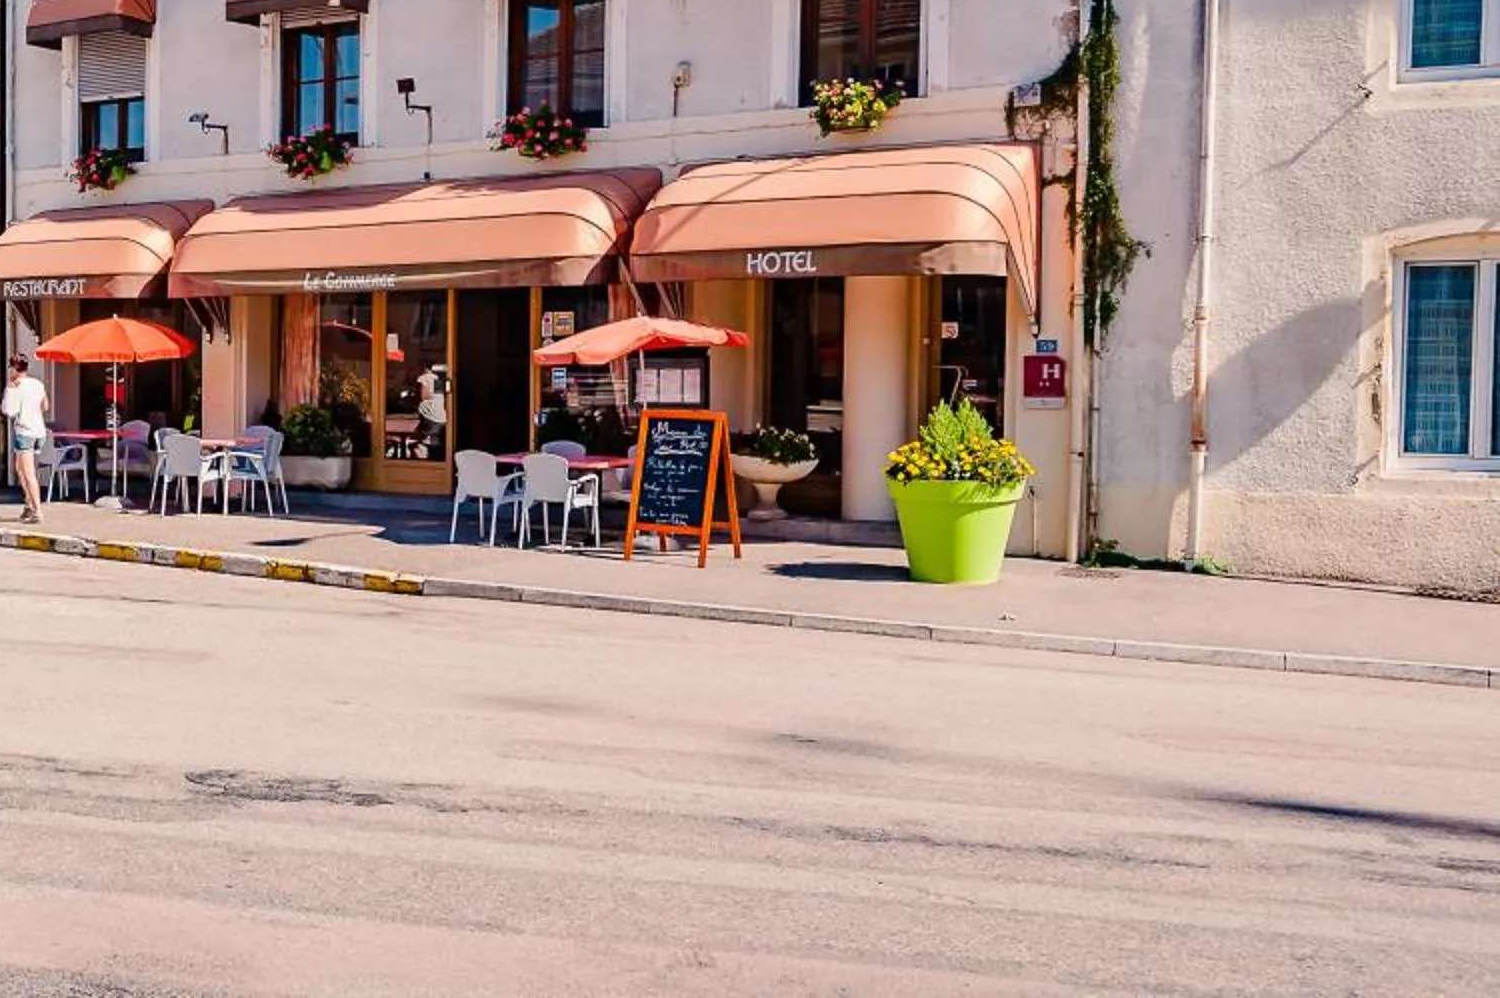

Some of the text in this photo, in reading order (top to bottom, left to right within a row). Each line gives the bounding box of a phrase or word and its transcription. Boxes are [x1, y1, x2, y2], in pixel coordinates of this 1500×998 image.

[747, 250, 817, 274] HOTEL
[3, 278, 87, 297] RESTAURANT
[1043, 363, 1060, 379] H
